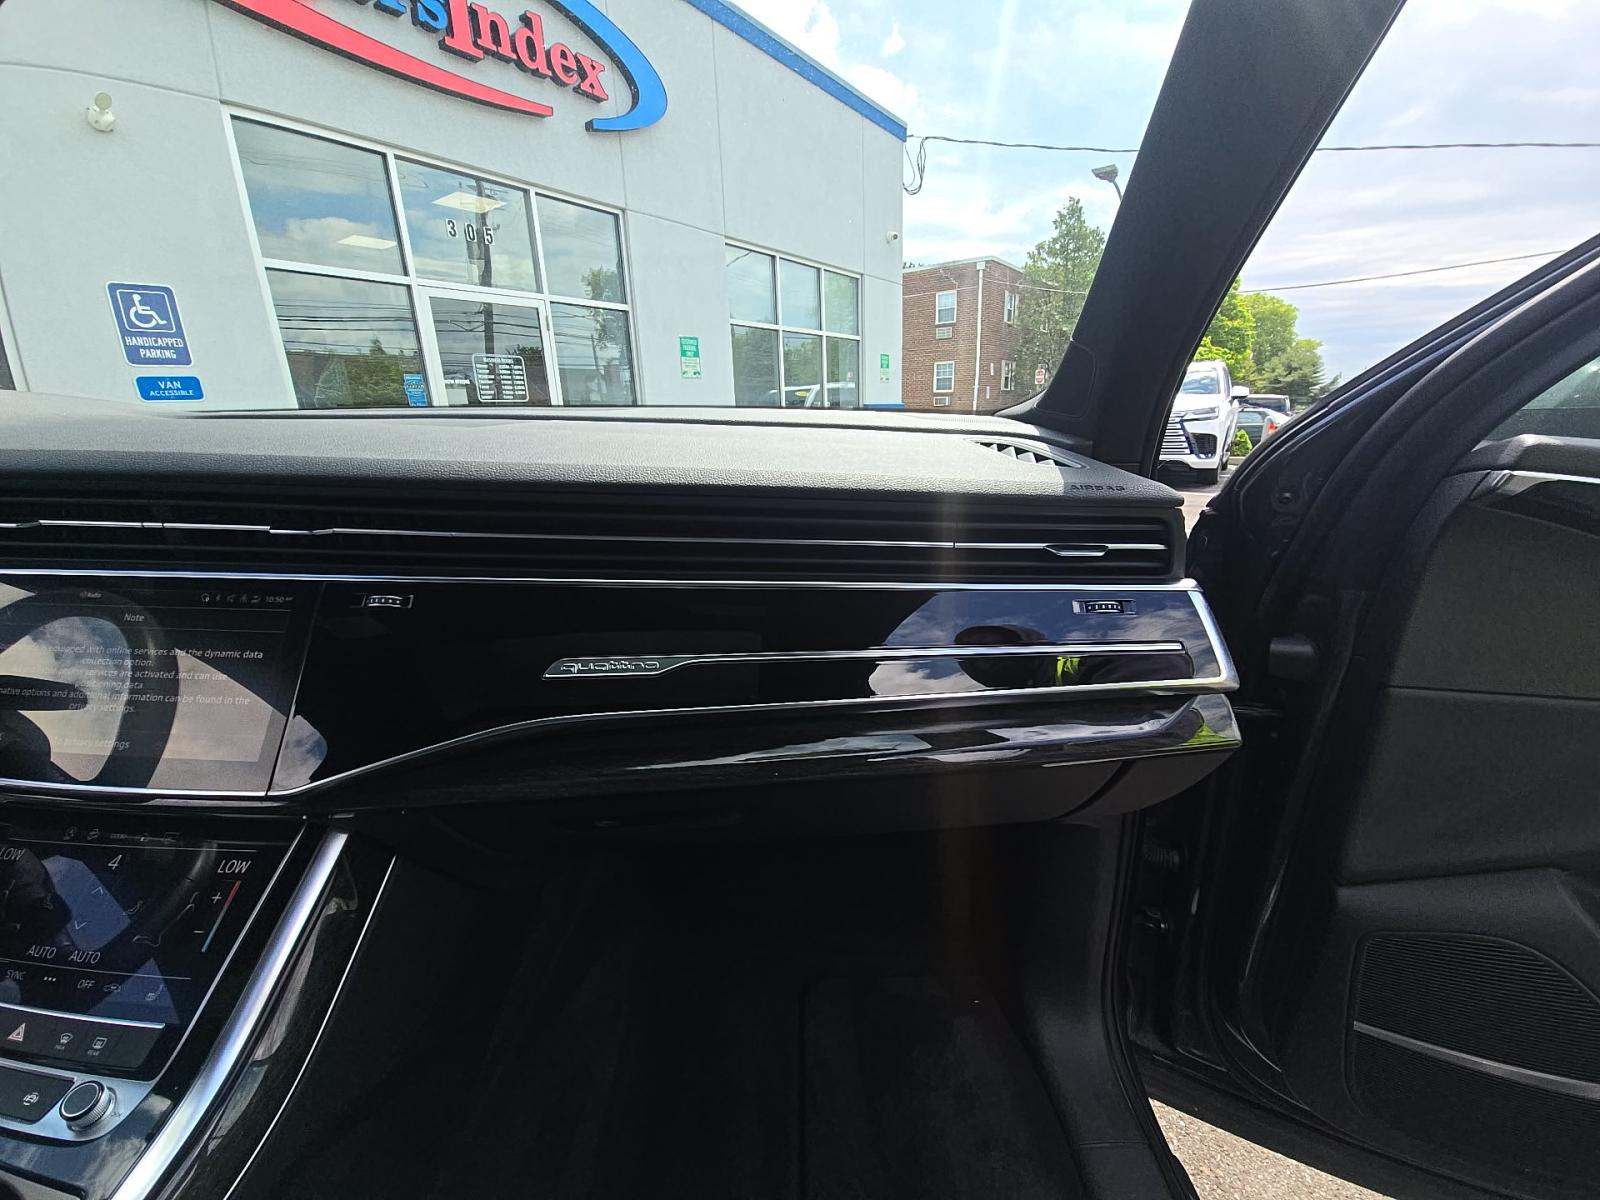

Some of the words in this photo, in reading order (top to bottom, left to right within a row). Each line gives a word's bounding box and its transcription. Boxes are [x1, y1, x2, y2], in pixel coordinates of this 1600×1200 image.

[372, 0, 609, 103] sIndex
[125, 336, 184, 348] HANDICAPPED
[139, 348, 177, 359] PARKING
[157, 381, 182, 389] VAN
[149, 389, 194, 397] ACCESSIBLE
[123, 612, 145, 623] Note
[134, 647, 169, 656] services
[188, 648, 203, 657] the
[204, 649, 241, 659] dynamic
[243, 649, 264, 659] data
[561, 660, 659, 674] quattro
[134, 670, 175, 679] activated
[123, 681, 143, 690] data
[21, 688, 51, 698] options
[52, 689, 68, 697] and
[195, 695, 222, 704] found
[224, 695, 234, 705] in
[235, 696, 251, 705] the
[107, 854, 123, 871] 4
[217, 859, 252, 874] LOW
[26, 944, 57, 960] AUTO
[68, 949, 101, 964] AUTO
[6, 969, 27, 981] SYNC
[77, 979, 97, 990] OFF
